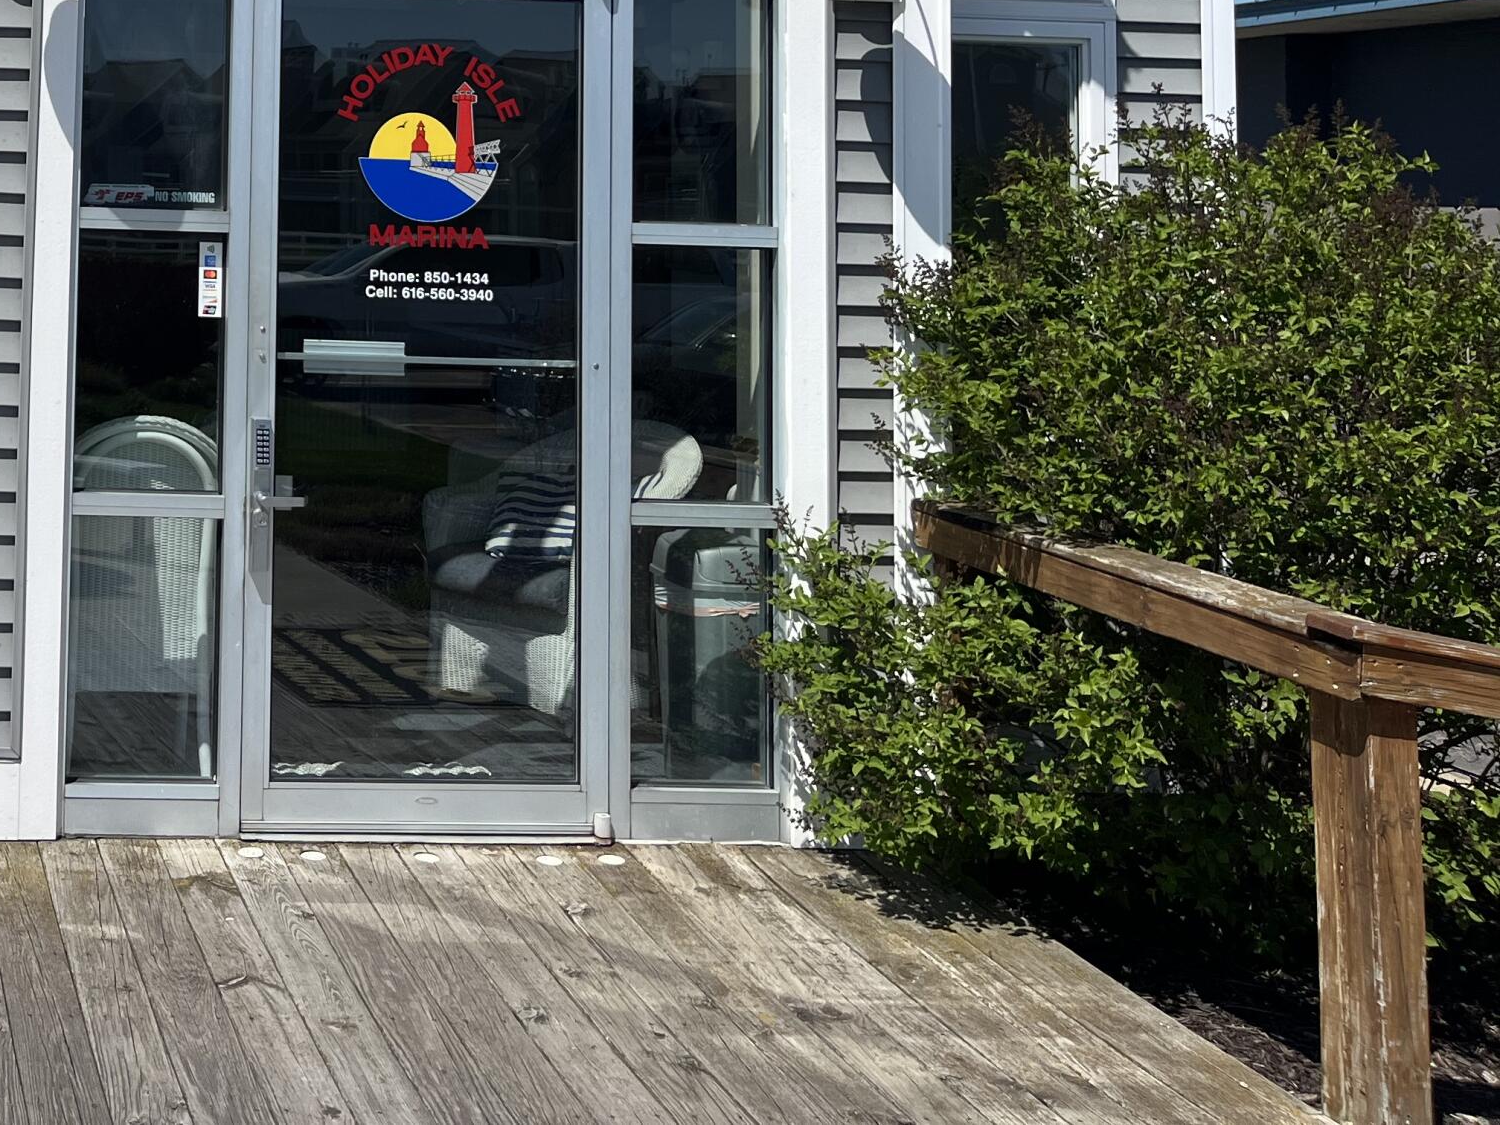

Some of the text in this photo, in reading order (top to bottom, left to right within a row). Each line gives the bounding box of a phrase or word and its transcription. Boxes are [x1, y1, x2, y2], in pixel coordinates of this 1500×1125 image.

[337, 43, 522, 123] HOLIDAY ISLE
[155, 191, 215, 203] NO SMOKING
[369, 224, 489, 249] MARINA
[369, 269, 489, 284] Phone: 850-1434
[365, 285, 494, 301] Cell: 616-560-3940
